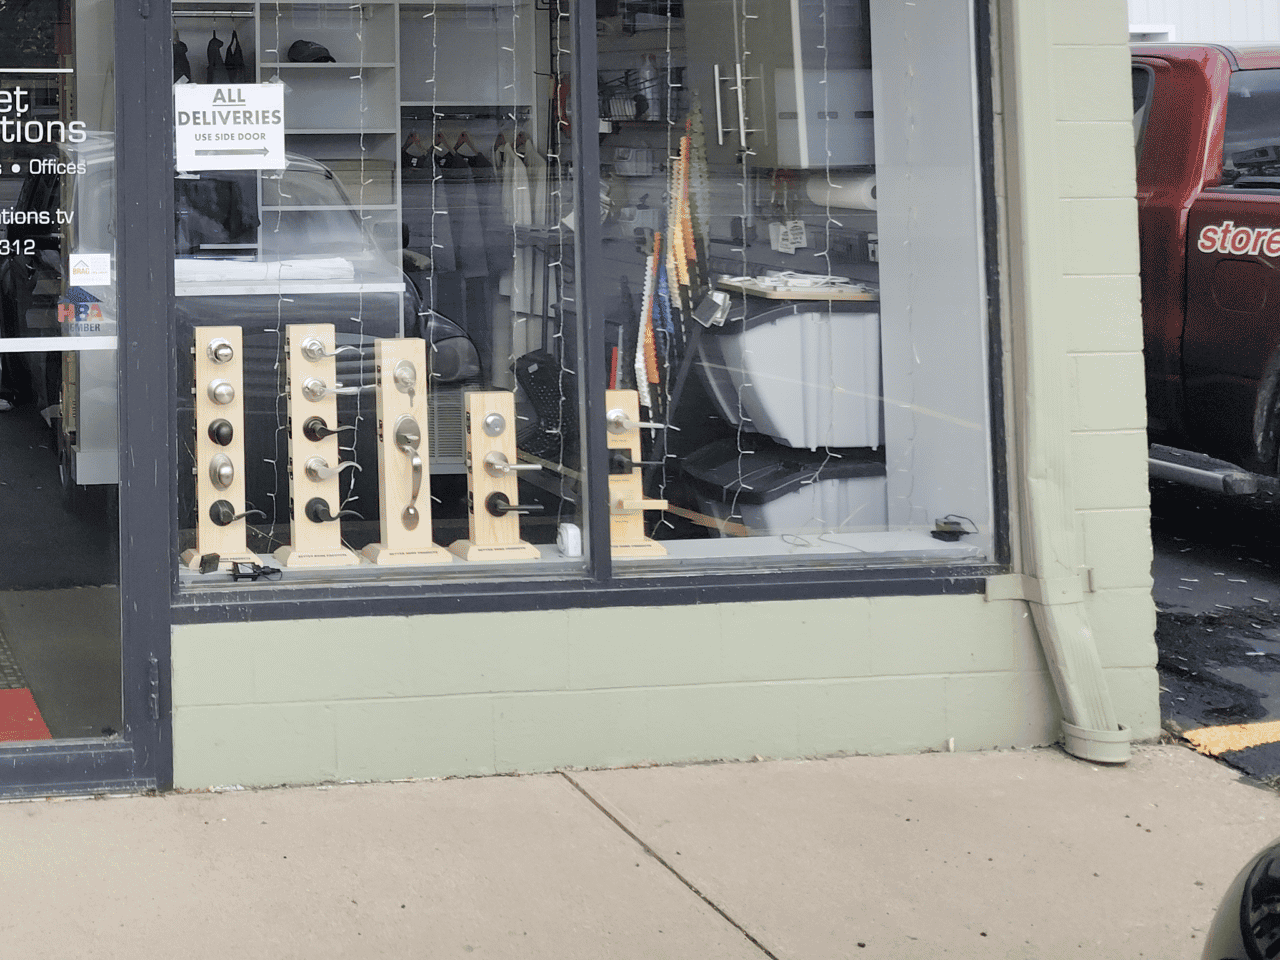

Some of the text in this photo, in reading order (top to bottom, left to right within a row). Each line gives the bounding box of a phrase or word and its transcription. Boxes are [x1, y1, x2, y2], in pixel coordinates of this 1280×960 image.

[212, 88, 246, 103] ALL
[178, 109, 282, 126] DELIVERIES
[194, 132, 266, 141] USE SIDE DOOR
[29, 159, 87, 175] Offices
[57, 304, 104, 322] HBA
[62, 323, 101, 332] EMBER
